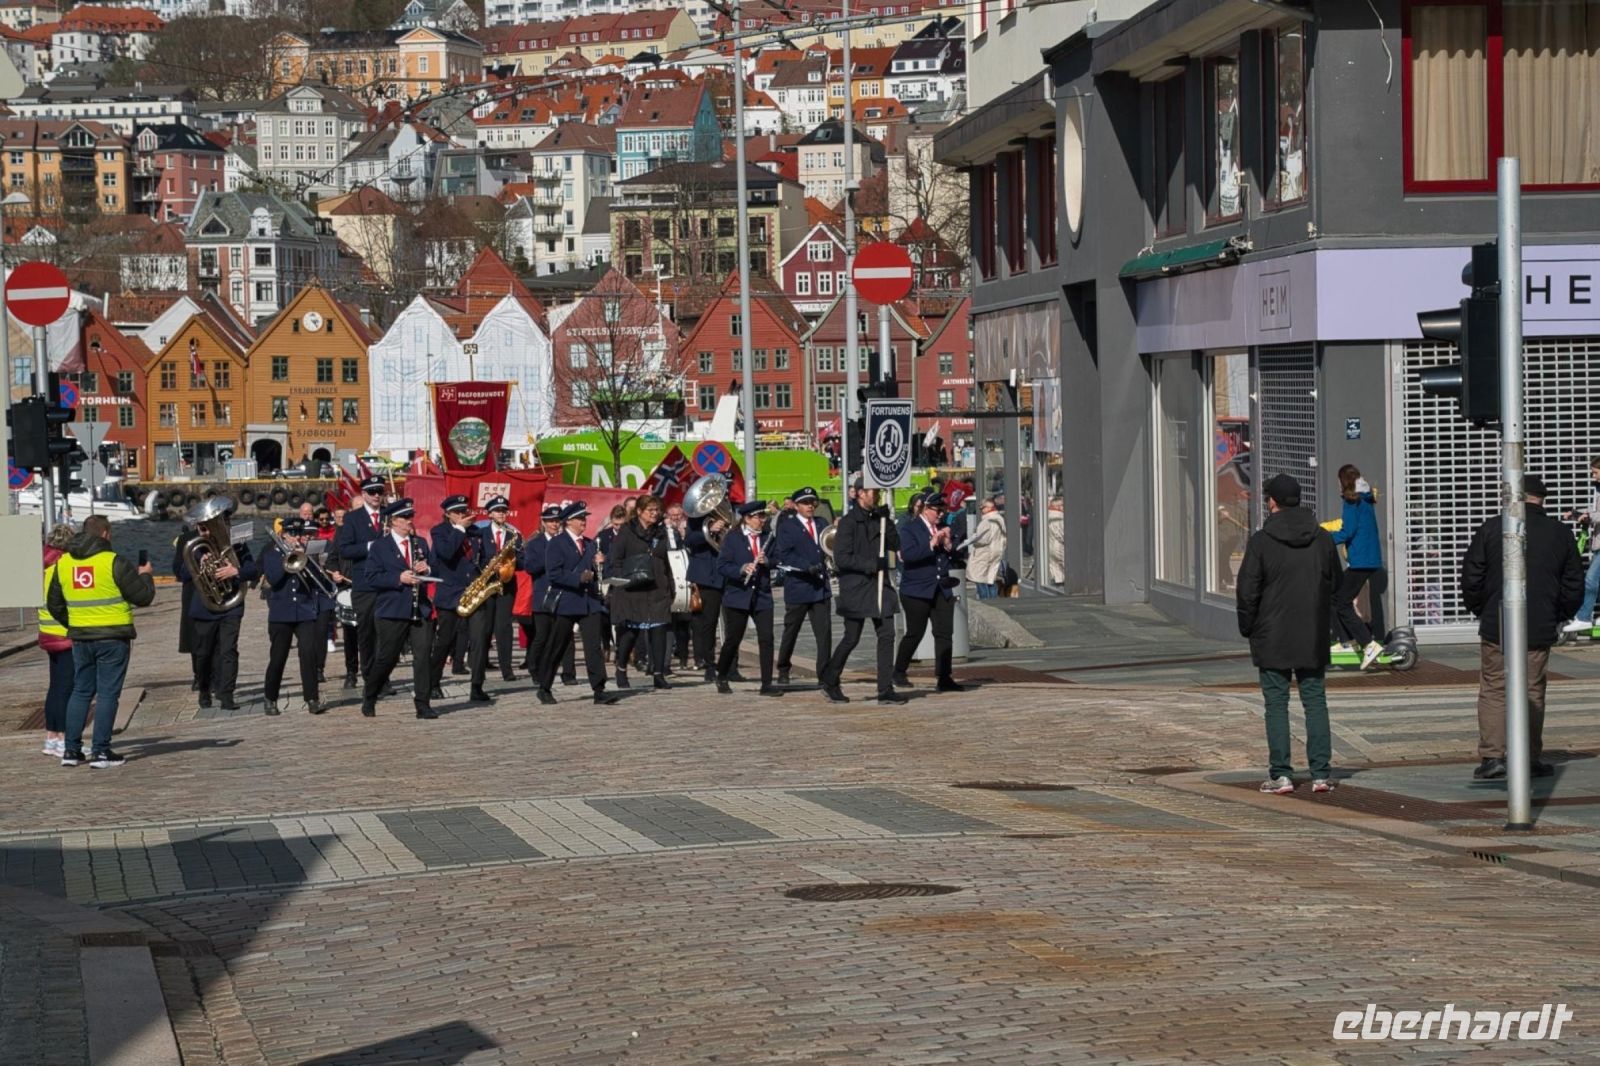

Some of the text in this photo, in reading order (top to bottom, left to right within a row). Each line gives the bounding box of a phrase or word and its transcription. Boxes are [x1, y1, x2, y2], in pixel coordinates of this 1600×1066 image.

[1526, 275, 1592, 305] HE
[1262, 285, 1288, 317] HEIM
[871, 406, 911, 416] FORTUNENS
[296, 429, 346, 437] SJØBODEN
[576, 443, 599, 452] TROLL
[869, 444, 910, 474] MUSIKKORPS
